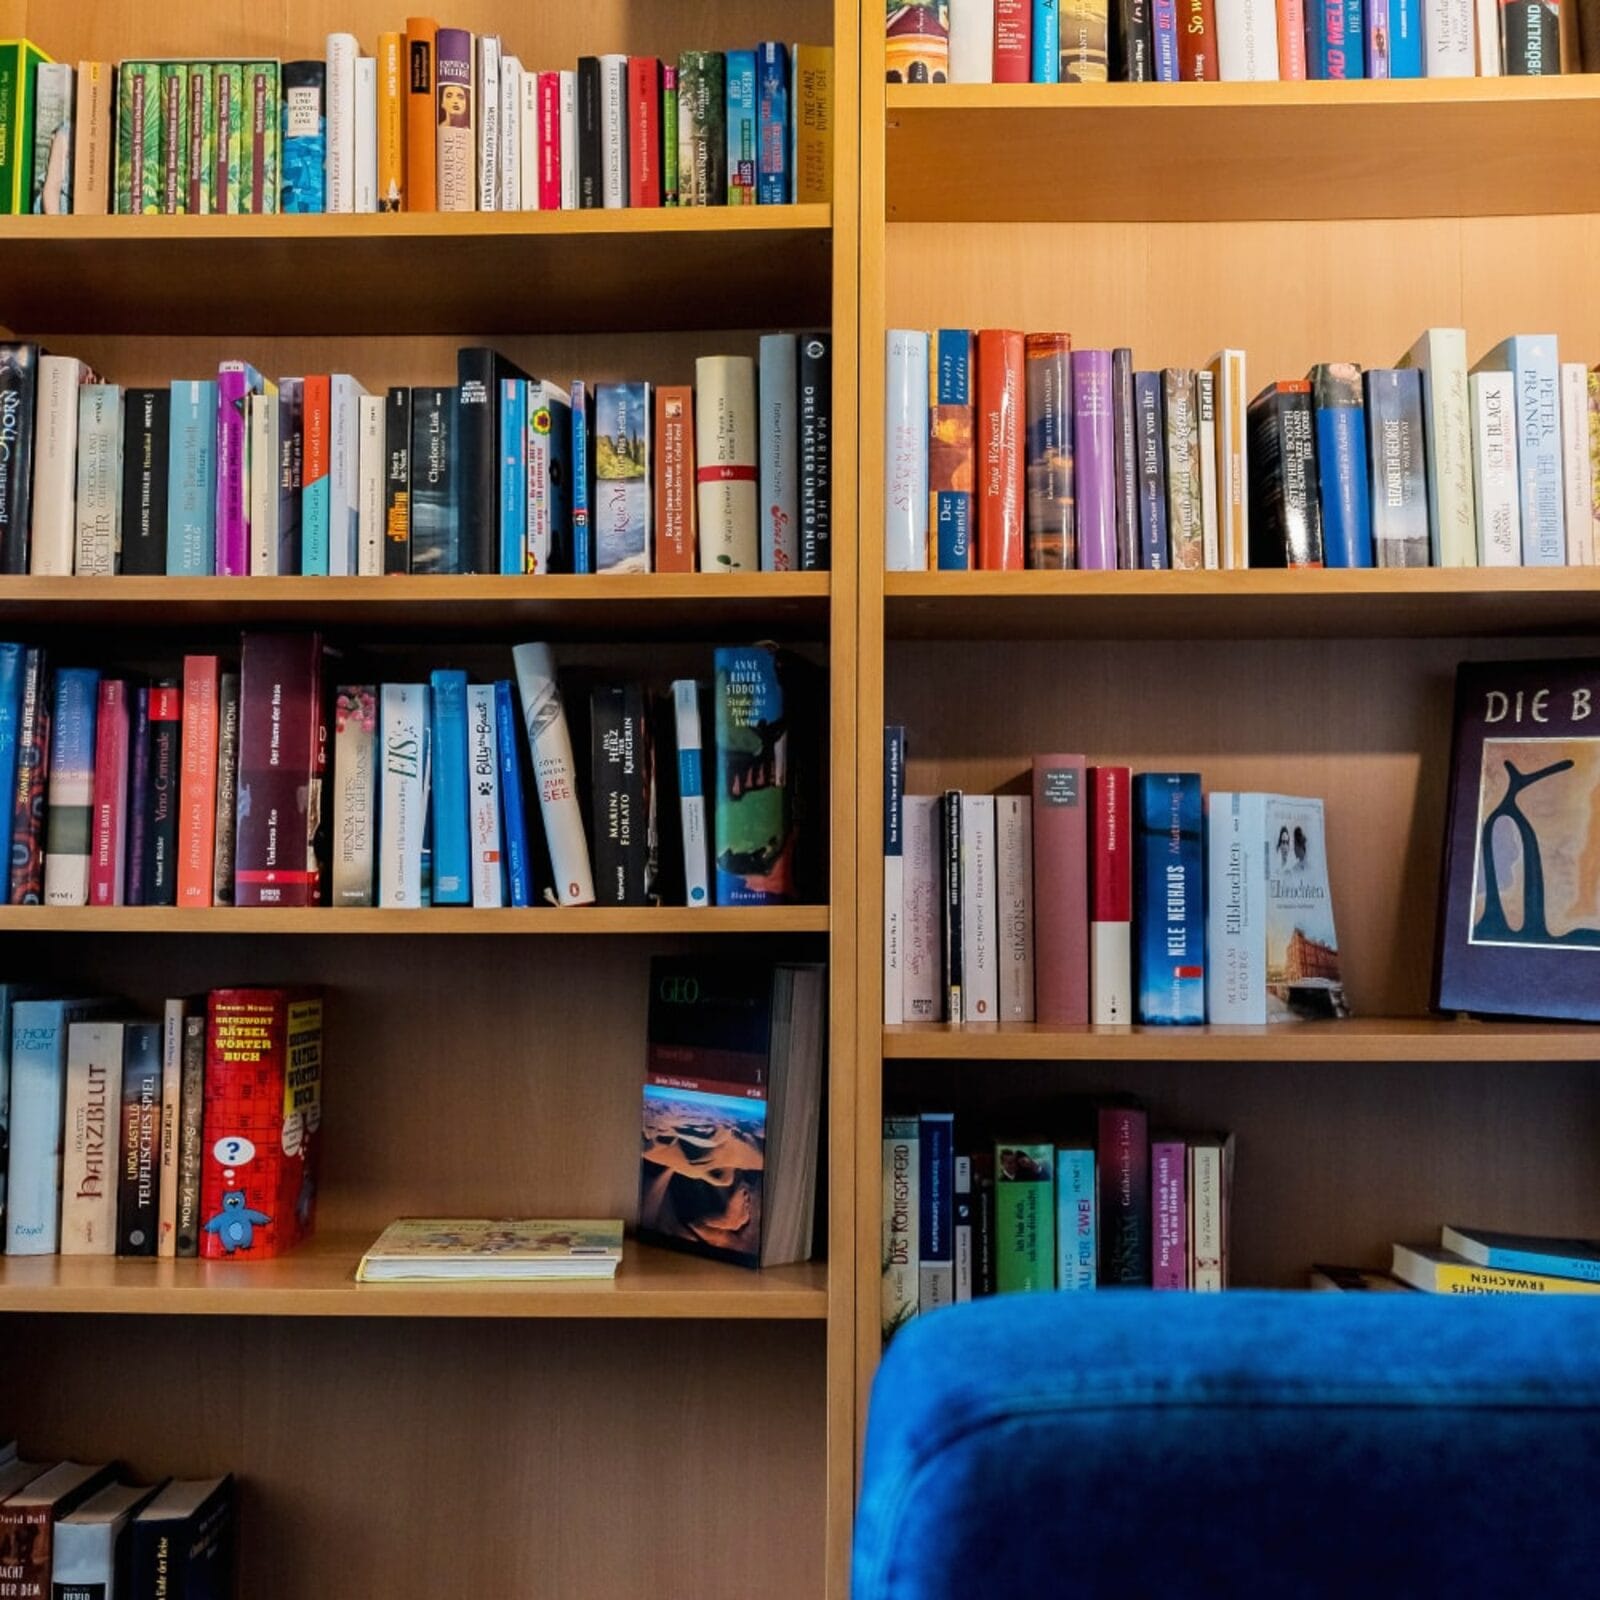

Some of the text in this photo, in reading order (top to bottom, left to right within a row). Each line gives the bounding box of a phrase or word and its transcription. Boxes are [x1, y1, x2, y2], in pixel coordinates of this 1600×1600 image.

[1188, 18, 1204, 35] So
[1526, 4, 1541, 68] BÖRJLIND
[730, 80, 742, 99] GIER
[742, 71, 753, 108] KERSTIN
[803, 69, 815, 126] EINE GANZ
[815, 69, 827, 132] DUMME IDEE
[443, 137, 454, 210] EFRORENE
[696, 140, 707, 207] LUCINDA RILEY
[942, 353, 952, 399] Timothy
[956, 355, 966, 400] Findley
[1202, 382, 1212, 421] PIPER
[674, 423, 682, 440] Bend
[1143, 389, 1157, 475] Bilder von ihr
[1485, 389, 1501, 437] BLACK
[1524, 370, 1540, 447] PRANGE
[1540, 378, 1555, 439] PETER
[428, 411, 439, 482] Charlotte Link
[665, 451, 673, 463] Die
[1284, 409, 1300, 504] STEPHEN BOOTH
[1294, 410, 1306, 489] SCHWARZE HAND
[1301, 410, 1312, 459] DES TODES
[613, 401, 629, 533] Kate Das Seehaus
[804, 386, 816, 568] DREI METER UNTER NULL
[816, 416, 828, 541] MARINA HEIB
[987, 467, 1001, 496] Tanja
[1340, 464, 1350, 481] Tod
[1385, 419, 1402, 507] ELIZABETH GEORGE
[674, 476, 682, 511] Liebenden
[940, 498, 951, 521] Der
[78, 522, 92, 572] JEFFREY
[665, 512, 674, 537] Robert
[723, 519, 732, 544] Maja
[954, 498, 966, 556] Gesandte
[726, 683, 767, 696] SIDDONS
[730, 671, 762, 683] RIVERS
[734, 660, 758, 671] ANNE
[477, 701, 492, 733] Beast
[1484, 688, 1550, 723] DIE
[222, 701, 236, 800] SCHATZ VERONA
[387, 737, 418, 779] EIS
[476, 749, 493, 776] Billy
[609, 728, 620, 763] HERZ
[623, 717, 634, 774] KRIEGERIN
[154, 732, 170, 822] Vino Criminale
[266, 685, 280, 866] Umberto Eco Der Name der Rose
[543, 787, 571, 803] SEE
[189, 803, 201, 870] JENNY HAN
[343, 816, 354, 863] BRENDA
[354, 816, 366, 852] JOYCE
[609, 791, 618, 838] MARINA
[620, 793, 631, 845] FIORATO
[616, 866, 625, 900] blanvalet
[1166, 793, 1186, 956] NELE NEUHAUS Muttertag
[1226, 842, 1241, 936] Elbleuchten
[1013, 899, 1026, 962] SIMONS
[976, 944, 985, 970] ANNE
[1227, 948, 1236, 1004] MIRIAM
[1239, 950, 1249, 1002] GEORG
[215, 1038, 272, 1049] WÖRTER
[219, 1025, 269, 1037] RÄTSEL
[224, 1051, 261, 1062] BUCH
[127, 1103, 140, 1180] LINDA CASTILLO
[139, 1075, 154, 1208] TEUFLISCHES SPIEL
[1119, 1119, 1131, 1206] Gefährliche Liebe
[181, 1126, 195, 1229] SCHATZ VERONA
[888, 1145, 910, 1265] DAS KÖNIGSPFERD
[1159, 1157, 1170, 1267] Fang jetzt bloß nicht
[1169, 1179, 1178, 1245] an zu lieben
[1077, 1199, 1091, 1266] FÜR ZWEI
[1118, 1215, 1139, 1281] PANEM
[1470, 1273, 1545, 1291] ERWACHEN
[20, 1583, 41, 1597] DEM
